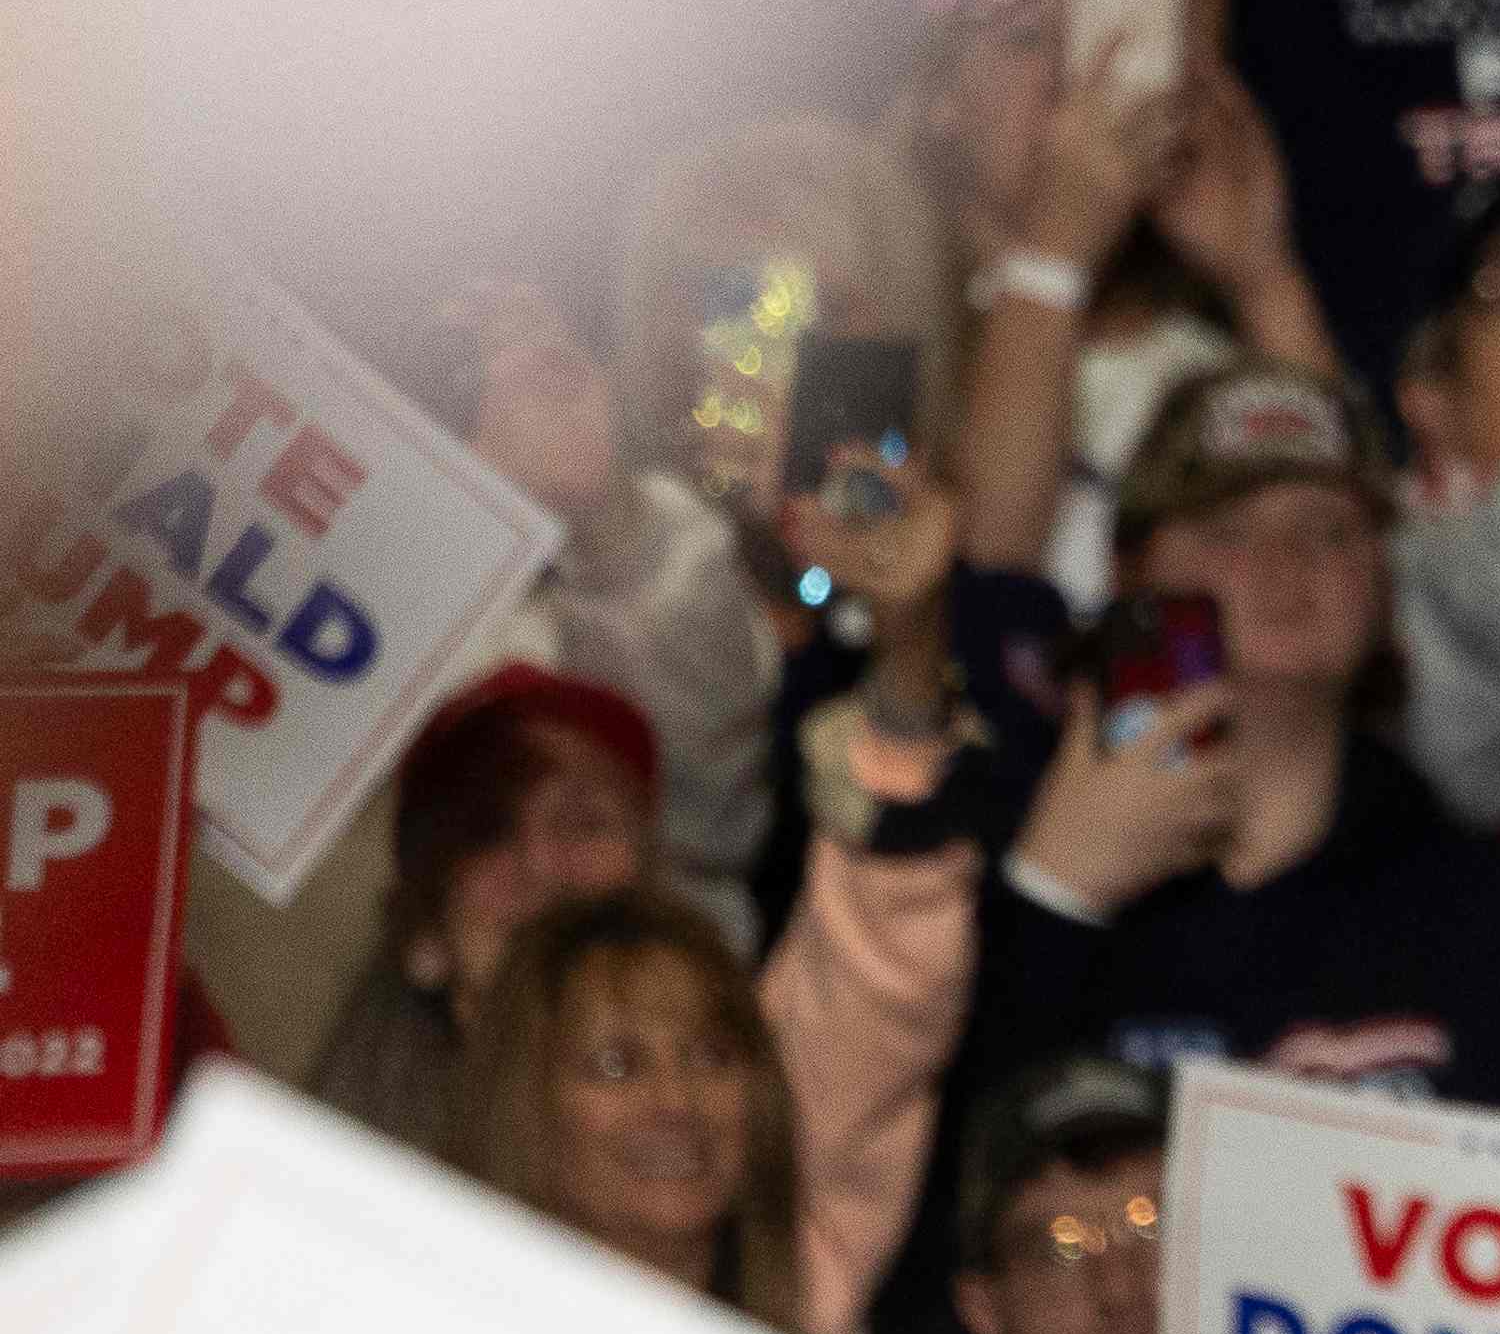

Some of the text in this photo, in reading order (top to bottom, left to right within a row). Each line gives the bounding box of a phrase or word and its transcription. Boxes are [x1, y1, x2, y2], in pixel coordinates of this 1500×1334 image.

[208, 378, 368, 539] TE
[15, 529, 281, 729] UMP
[111, 469, 381, 685] ALD
